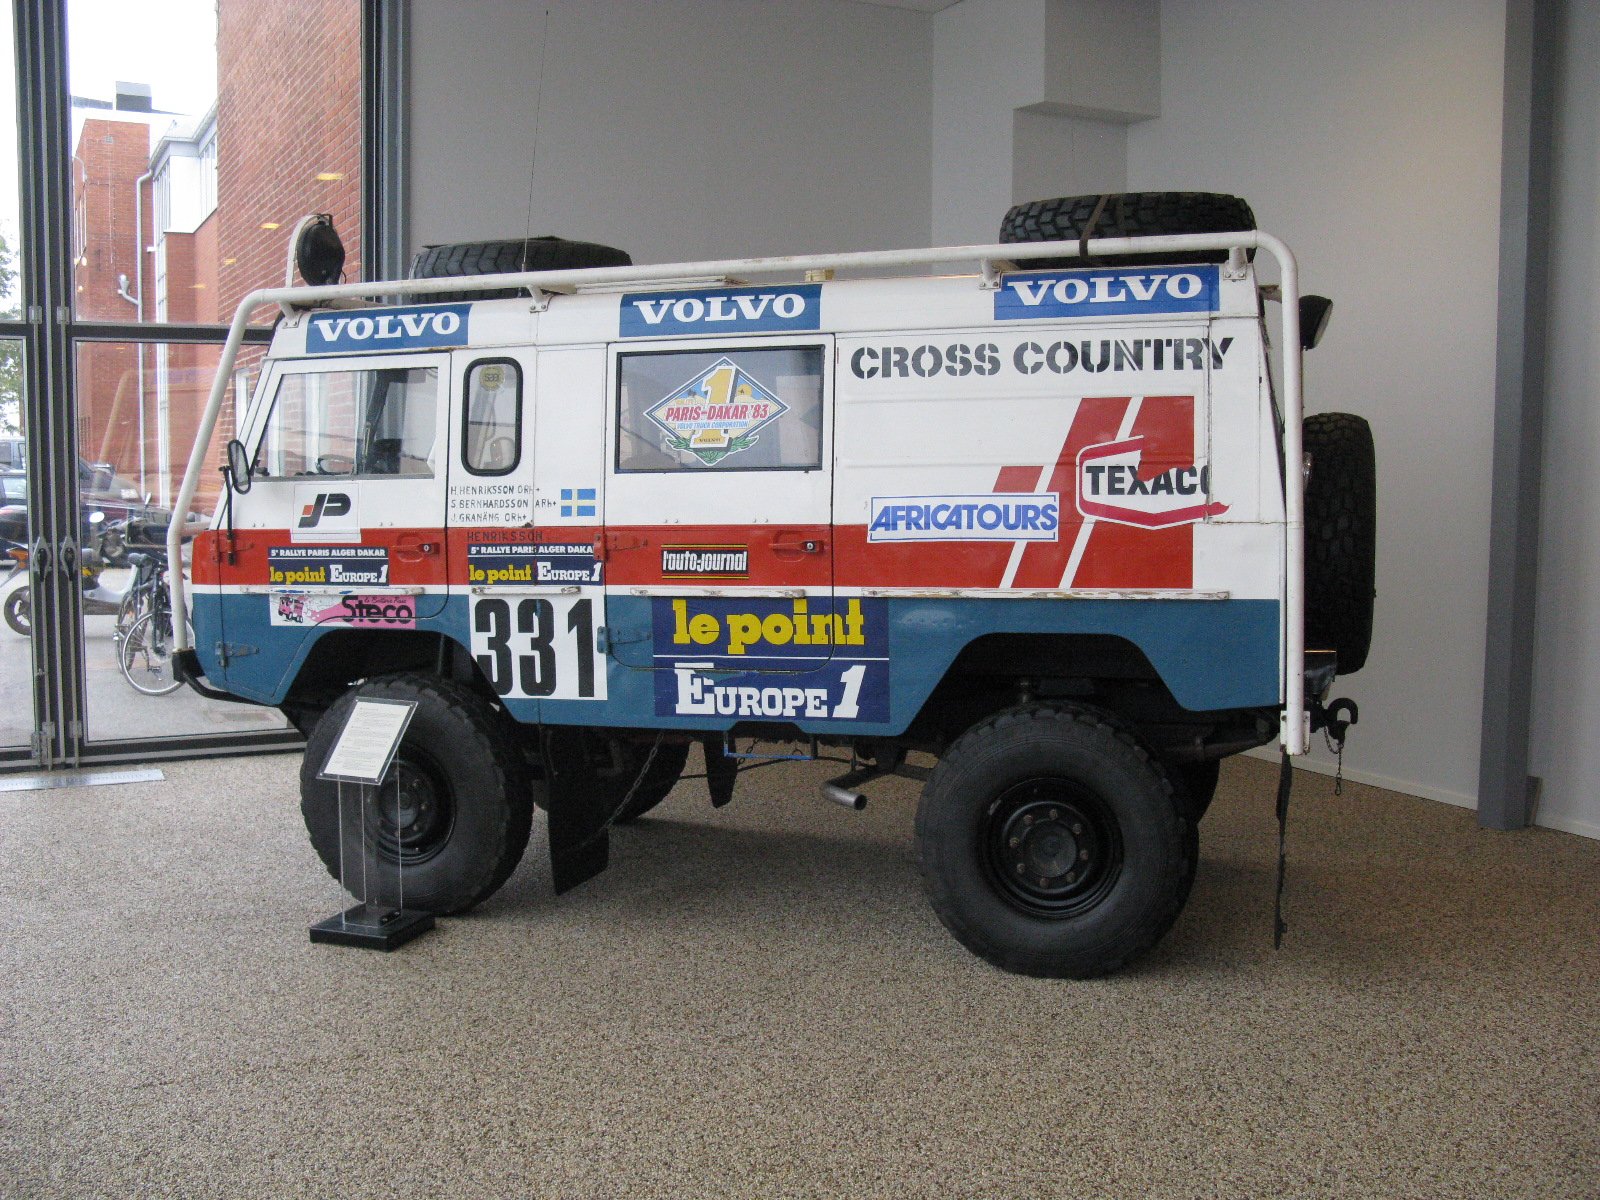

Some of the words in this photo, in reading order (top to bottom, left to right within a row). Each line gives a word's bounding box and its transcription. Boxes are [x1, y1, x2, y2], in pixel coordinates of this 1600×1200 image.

[1008, 273, 1203, 306] VOLVO
[633, 293, 806, 325] VOLVO
[313, 311, 461, 342] VOLVO
[850, 343, 1001, 380] CROSS
[1012, 337, 1234, 375] COUNTRY
[869, 502, 1058, 532] AFRICATOURS
[467, 531, 543, 542] HENRIKSSON
[480, 546, 511, 554] RALLYE
[537, 546, 567, 554] ALGER
[279, 549, 307, 557] RALLYE
[307, 549, 330, 557] PARIS
[331, 549, 356, 557] ALGER
[357, 549, 386, 557] DAKAR
[269, 566, 285, 582] le
[285, 566, 326, 585] point
[378, 564, 389, 583] 1
[469, 564, 487, 581] le
[487, 564, 533, 584] point
[590, 562, 602, 582] 1
[341, 595, 413, 626] Steco
[672, 599, 720, 645] le
[726, 599, 865, 655] point
[474, 597, 596, 698] 331
[831, 664, 867, 719] 1
